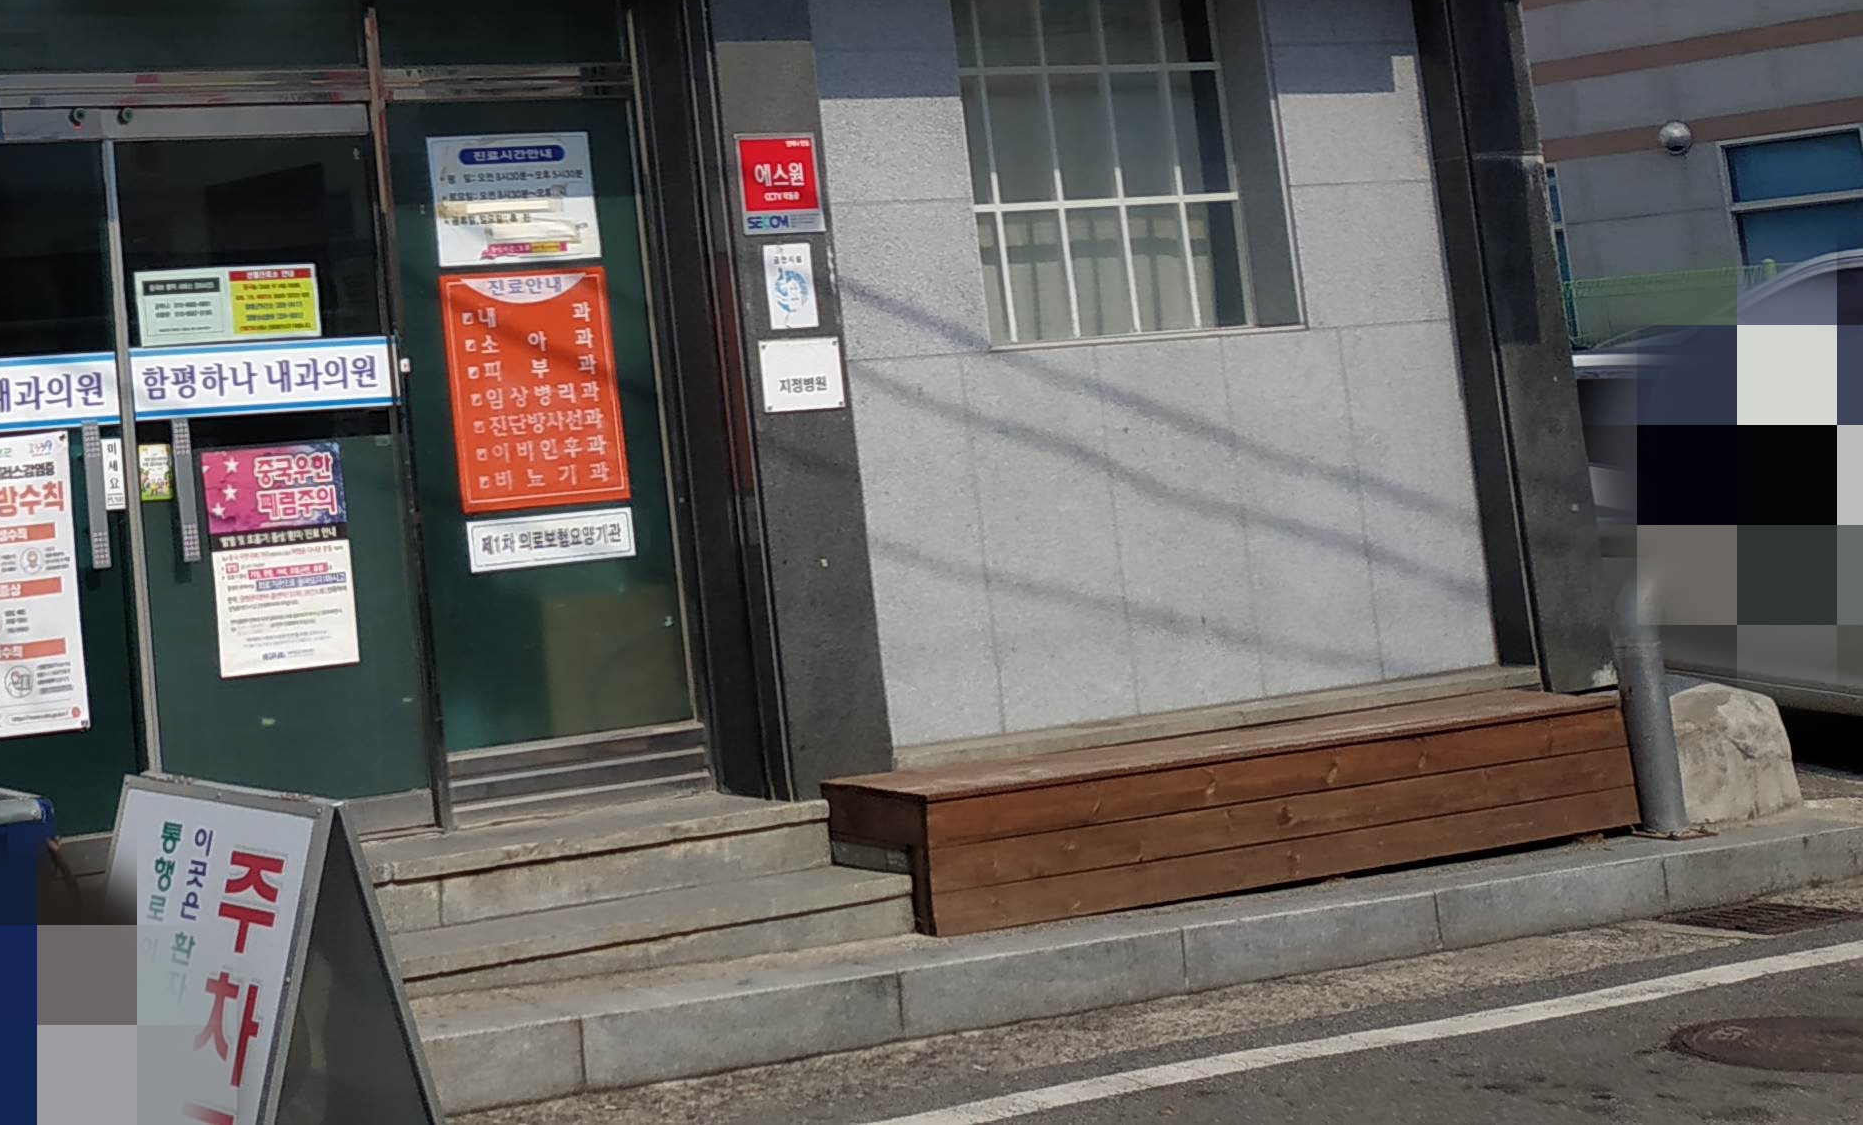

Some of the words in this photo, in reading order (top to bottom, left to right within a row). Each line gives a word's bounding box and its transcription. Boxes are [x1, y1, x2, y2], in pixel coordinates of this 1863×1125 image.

[473, 148, 553, 162] 진료시간안내
[754, 162, 805, 187] 에스원
[747, 215, 789, 229] SECOM
[489, 276, 562, 295] 진료안내
[142, 361, 257, 400] 함평하나
[264, 355, 378, 393] 내과의원
[778, 376, 827, 393] 지정병원
[489, 409, 604, 436] 진단방사선과
[255, 452, 332, 488] 중국우한
[482, 534, 515, 556] 제1차
